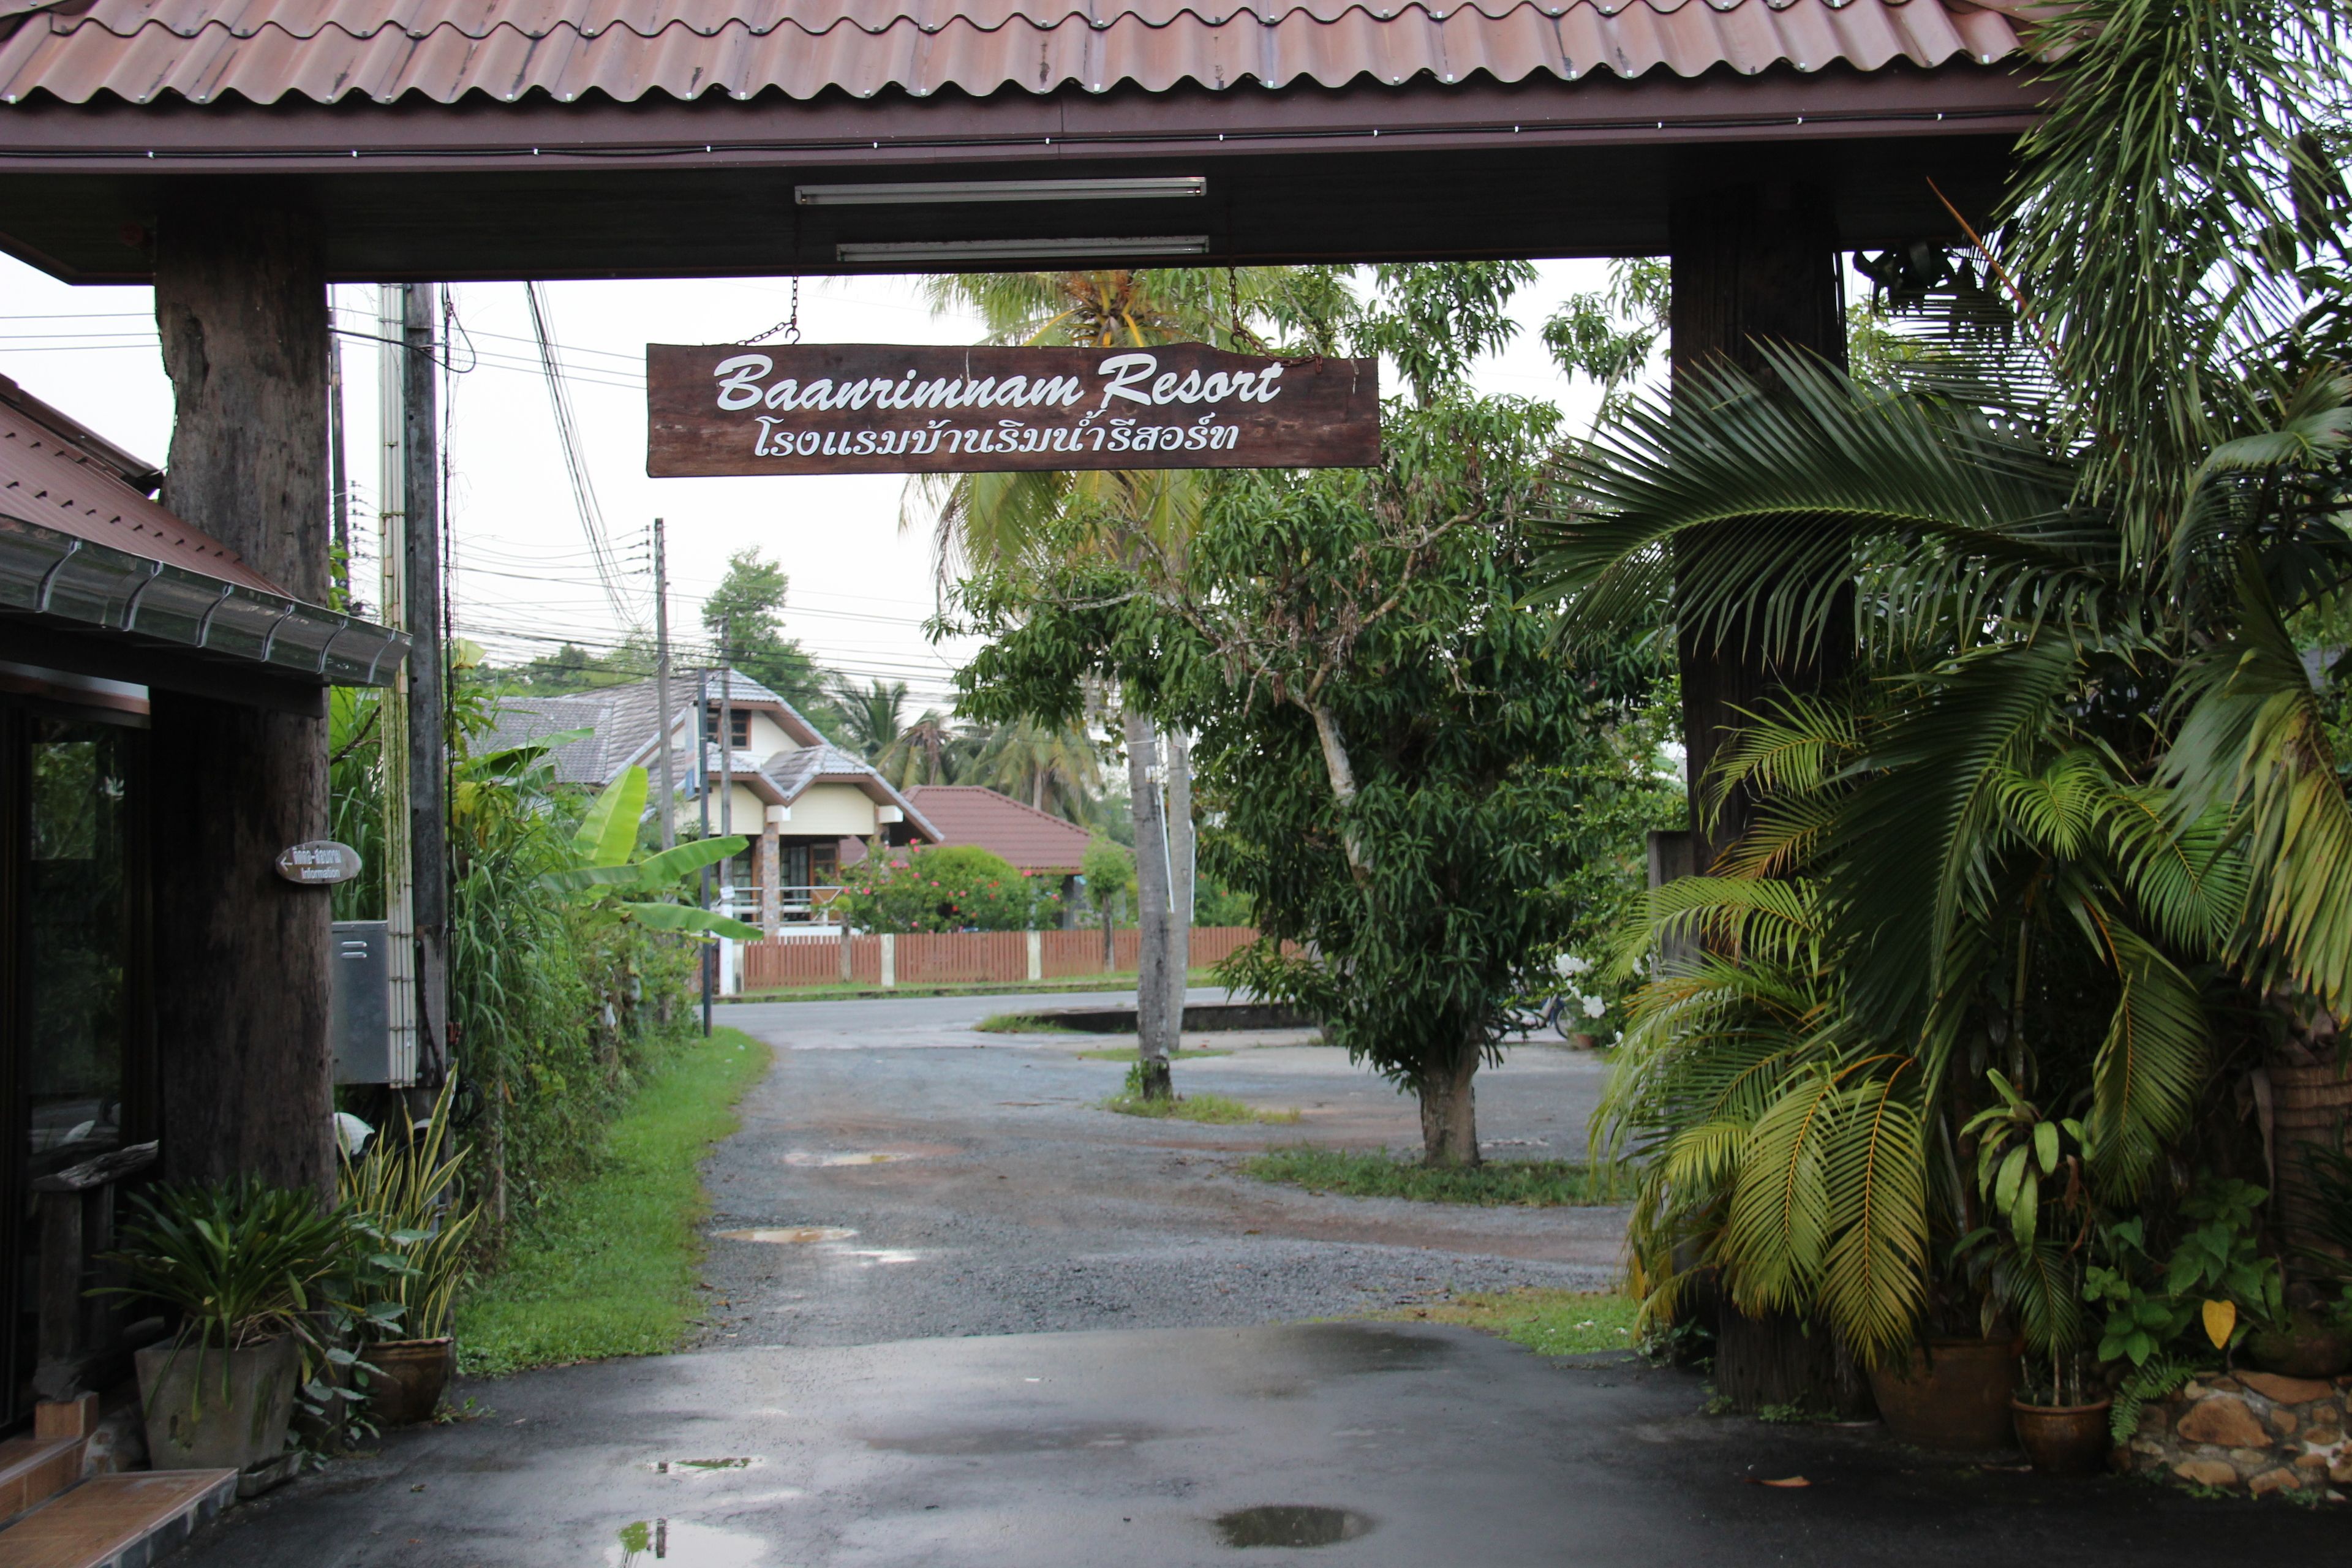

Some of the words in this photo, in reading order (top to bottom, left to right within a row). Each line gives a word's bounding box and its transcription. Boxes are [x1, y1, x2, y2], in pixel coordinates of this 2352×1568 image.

[714, 353, 1085, 411] Baanrimnam
[1098, 353, 1284, 409] Resort
[754, 409, 1240, 457] โรงแรมบ้านริมน้ำรีสอร์ท
[301, 867, 341, 879] Information
